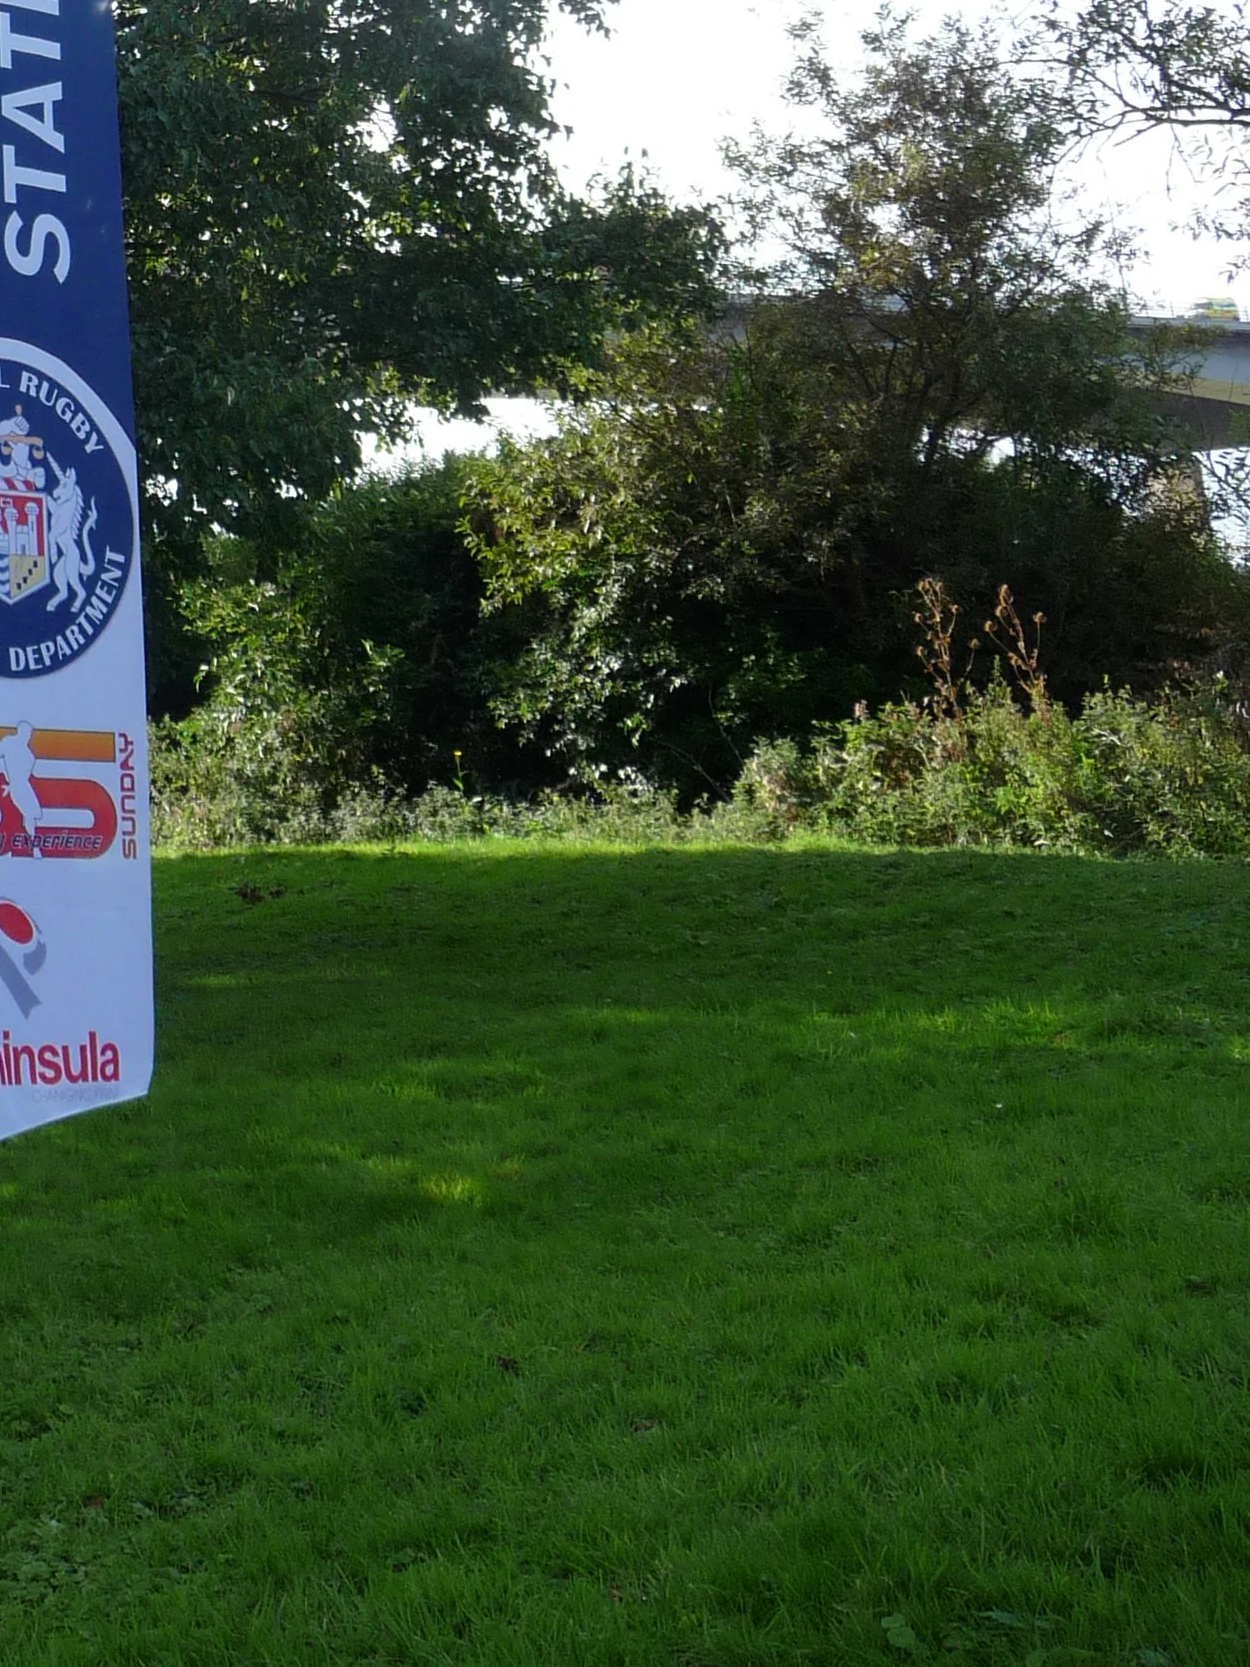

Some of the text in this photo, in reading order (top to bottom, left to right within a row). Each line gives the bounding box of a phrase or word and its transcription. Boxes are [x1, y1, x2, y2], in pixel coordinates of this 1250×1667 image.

[19, 371, 105, 454] RUGBY
[9, 545, 127, 672] DEPARTMENT
[12, 829, 103, 851] experience
[119, 732, 137, 860] SUNDAY
